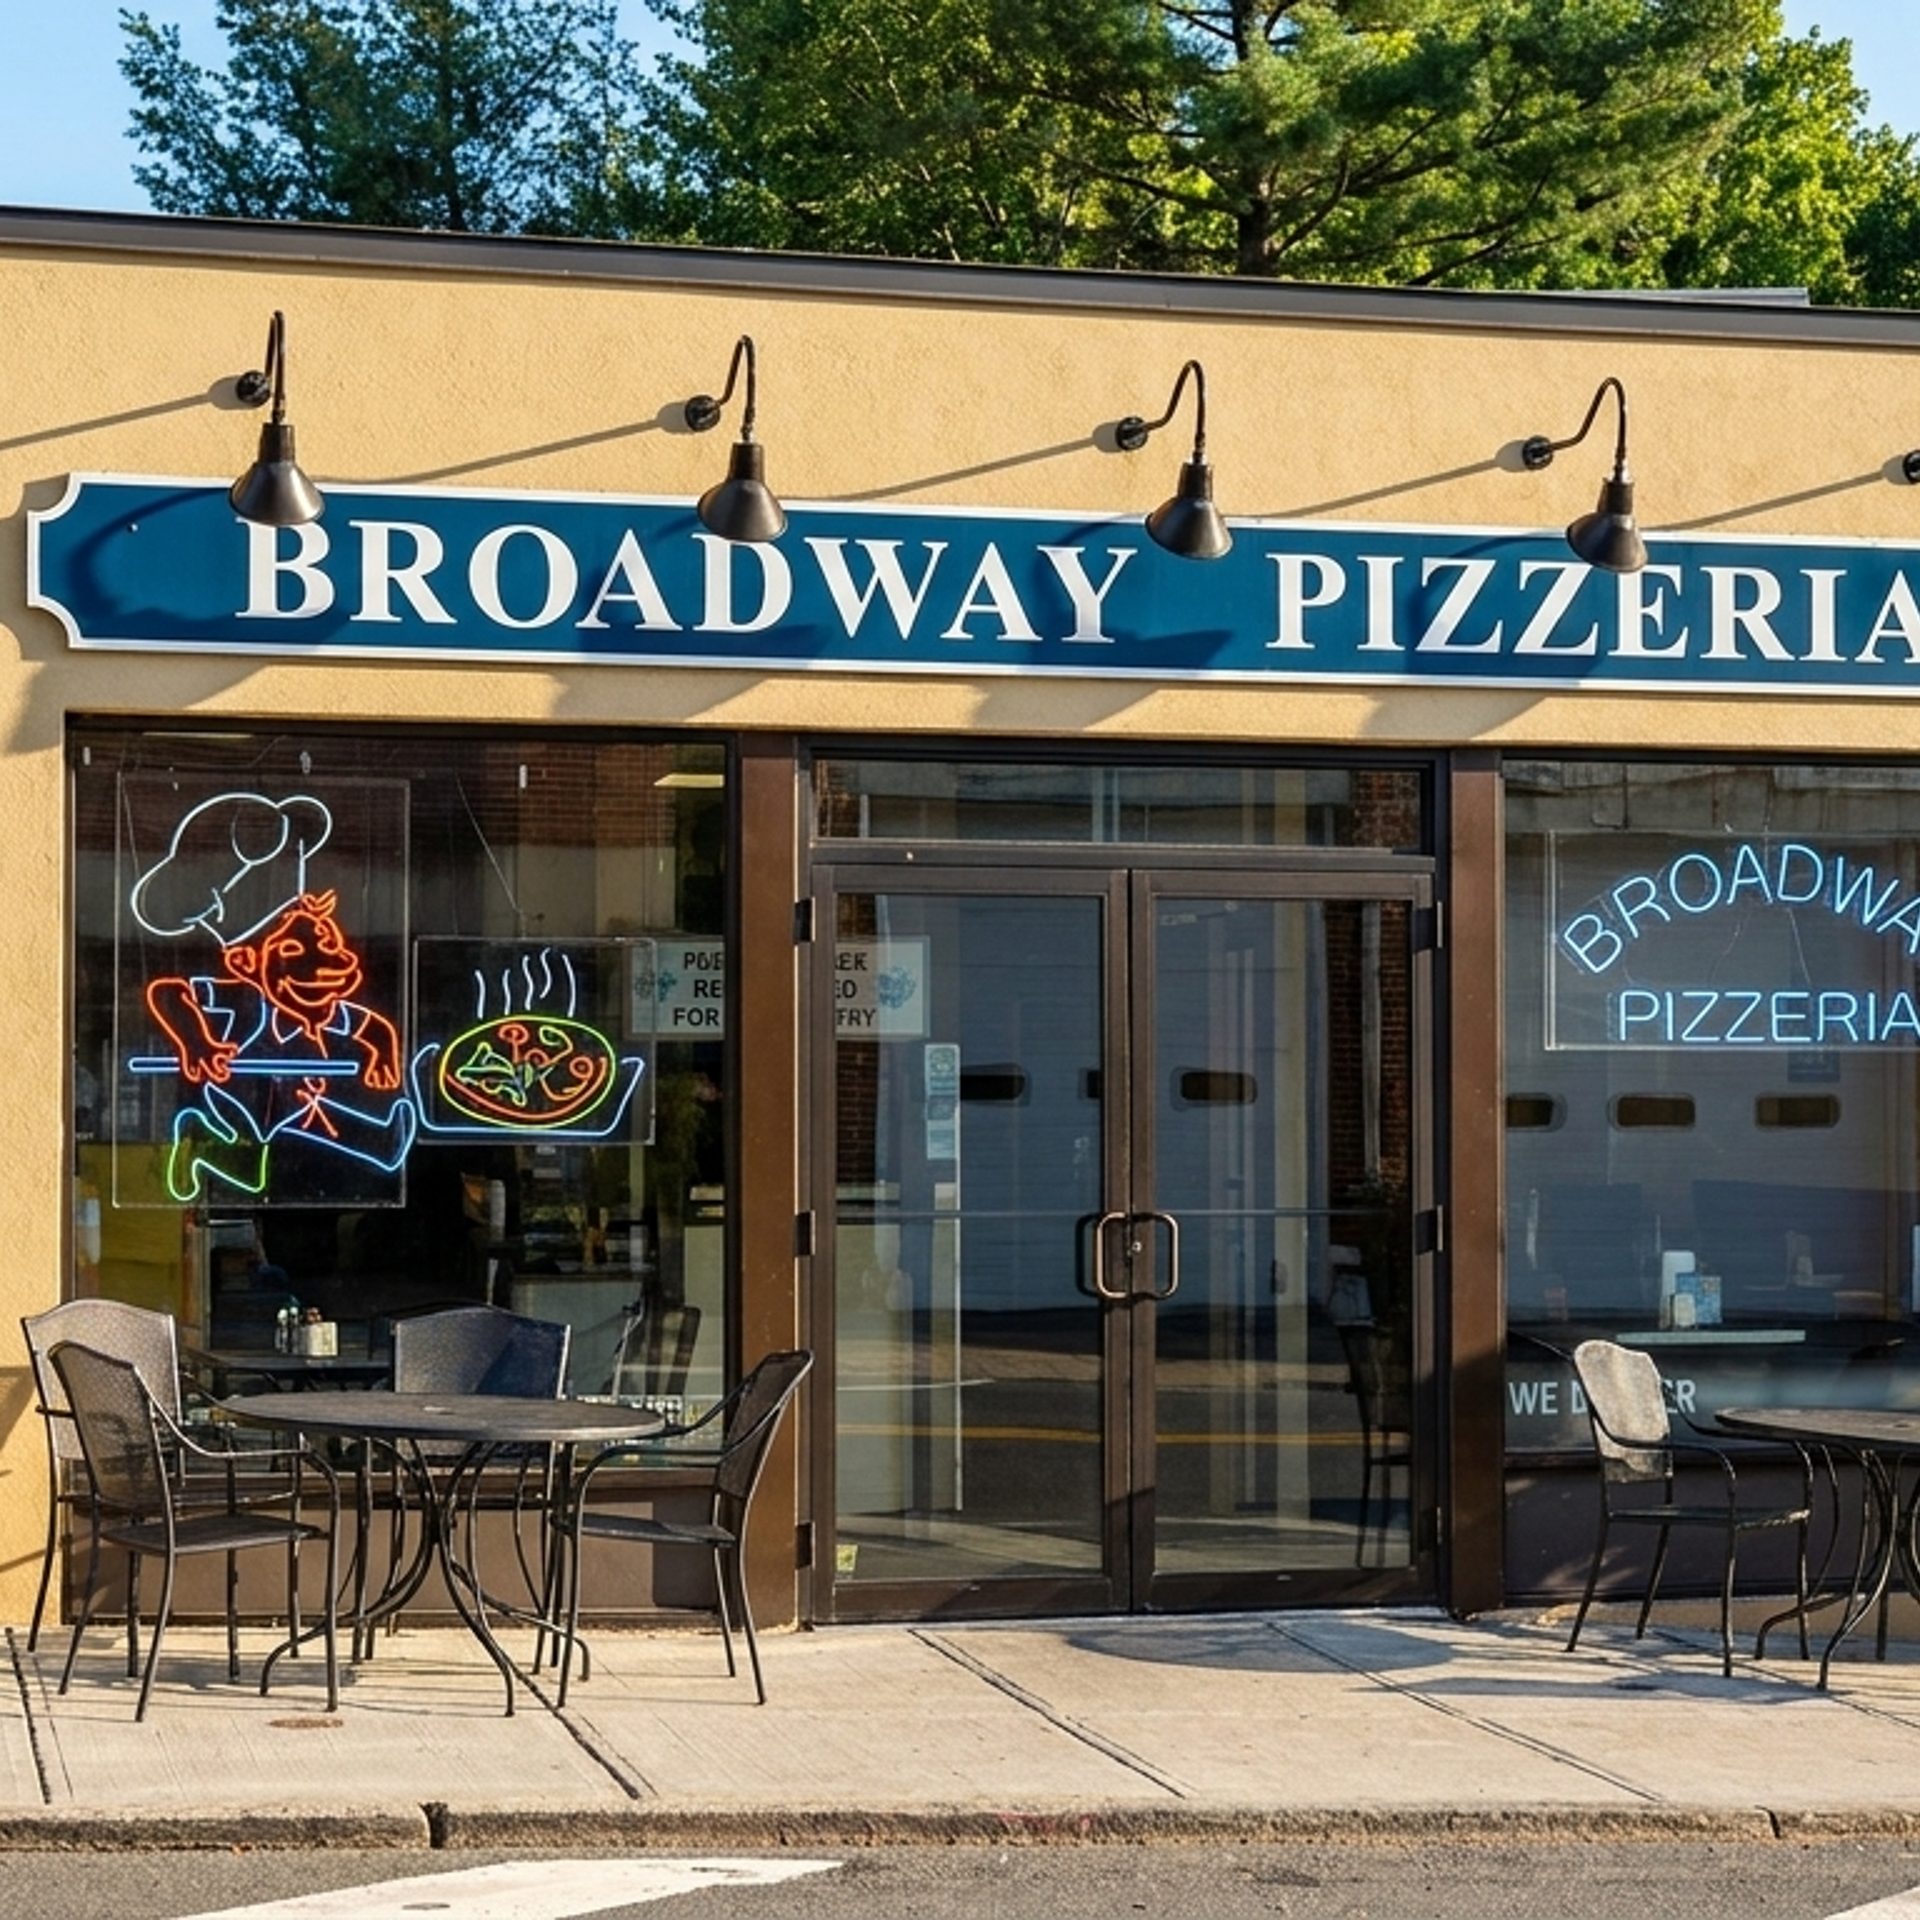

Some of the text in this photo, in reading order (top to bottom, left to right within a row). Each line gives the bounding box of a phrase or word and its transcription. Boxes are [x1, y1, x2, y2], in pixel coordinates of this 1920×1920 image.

[235, 516, 1920, 664] BROADWAY PIZZERIA
[1563, 844, 1920, 974] BROADWA
[673, 1007, 719, 1026] FOR
[1618, 990, 1920, 1042] PIZZERIA
[1508, 1381, 1559, 1416] WE
